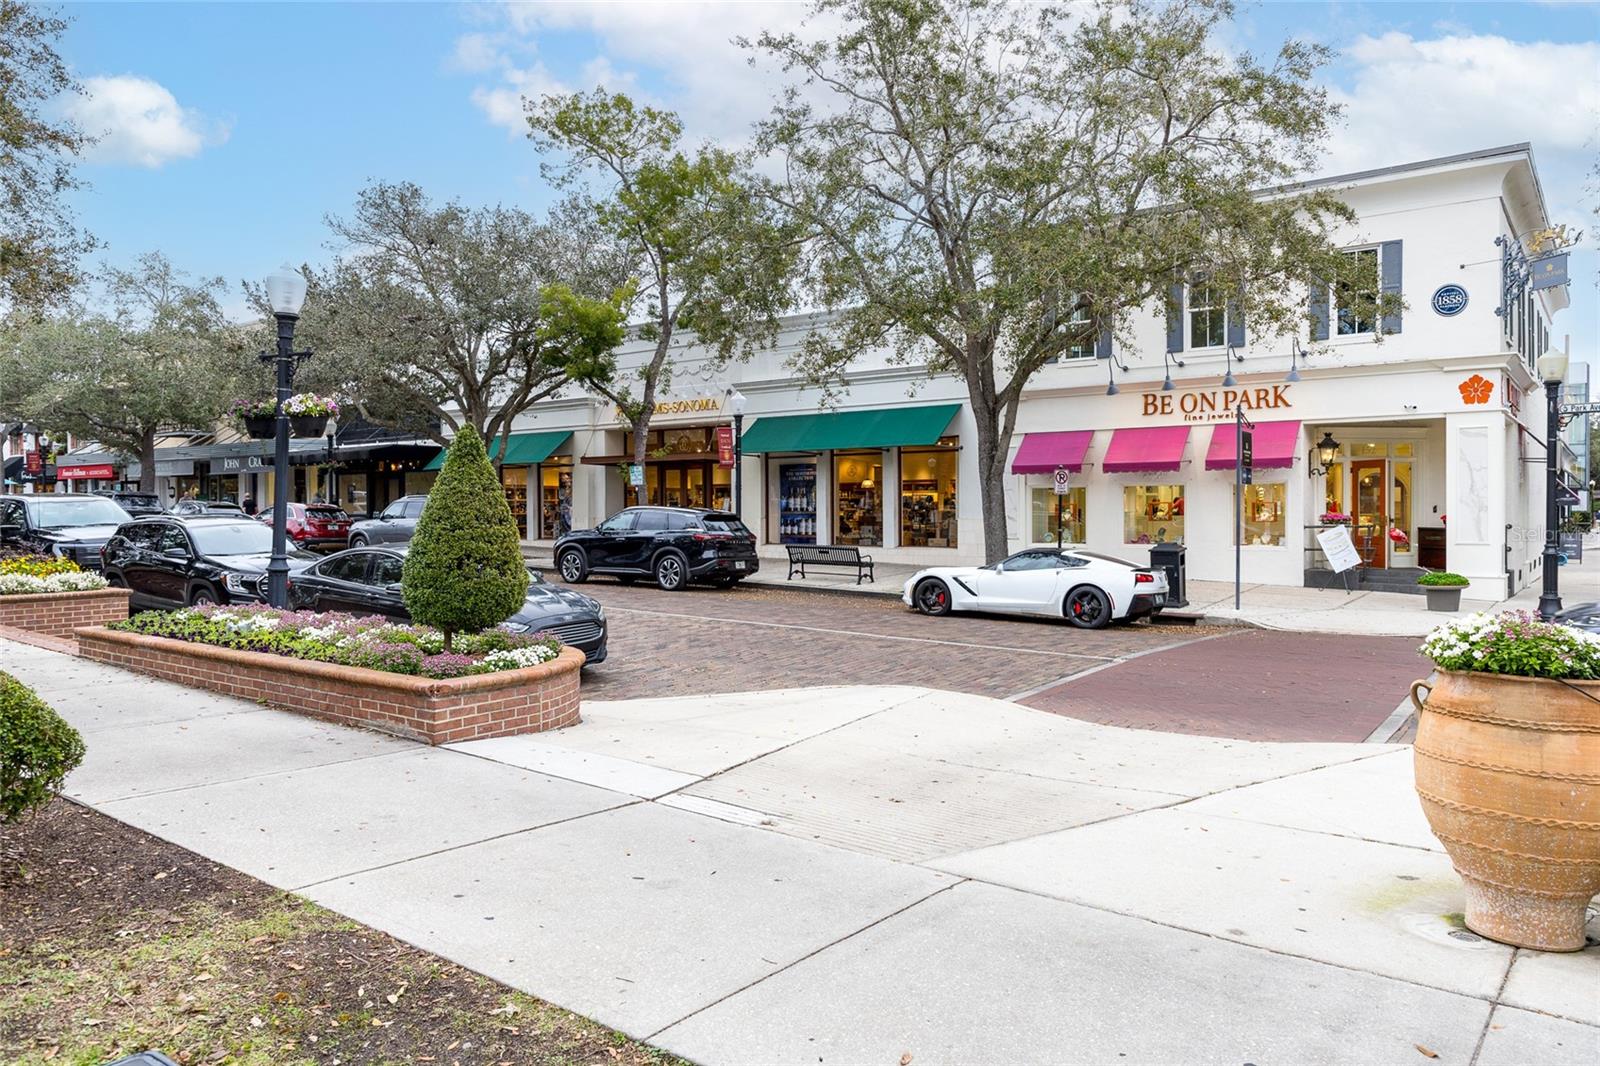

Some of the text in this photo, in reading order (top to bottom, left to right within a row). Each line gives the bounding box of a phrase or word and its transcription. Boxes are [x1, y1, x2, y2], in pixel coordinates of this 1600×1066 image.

[1438, 294, 1462, 306] 1858
[1142, 386, 1292, 416] BE ON PARK
[1184, 413, 1203, 421] fine
[224, 457, 240, 471] JOHN
